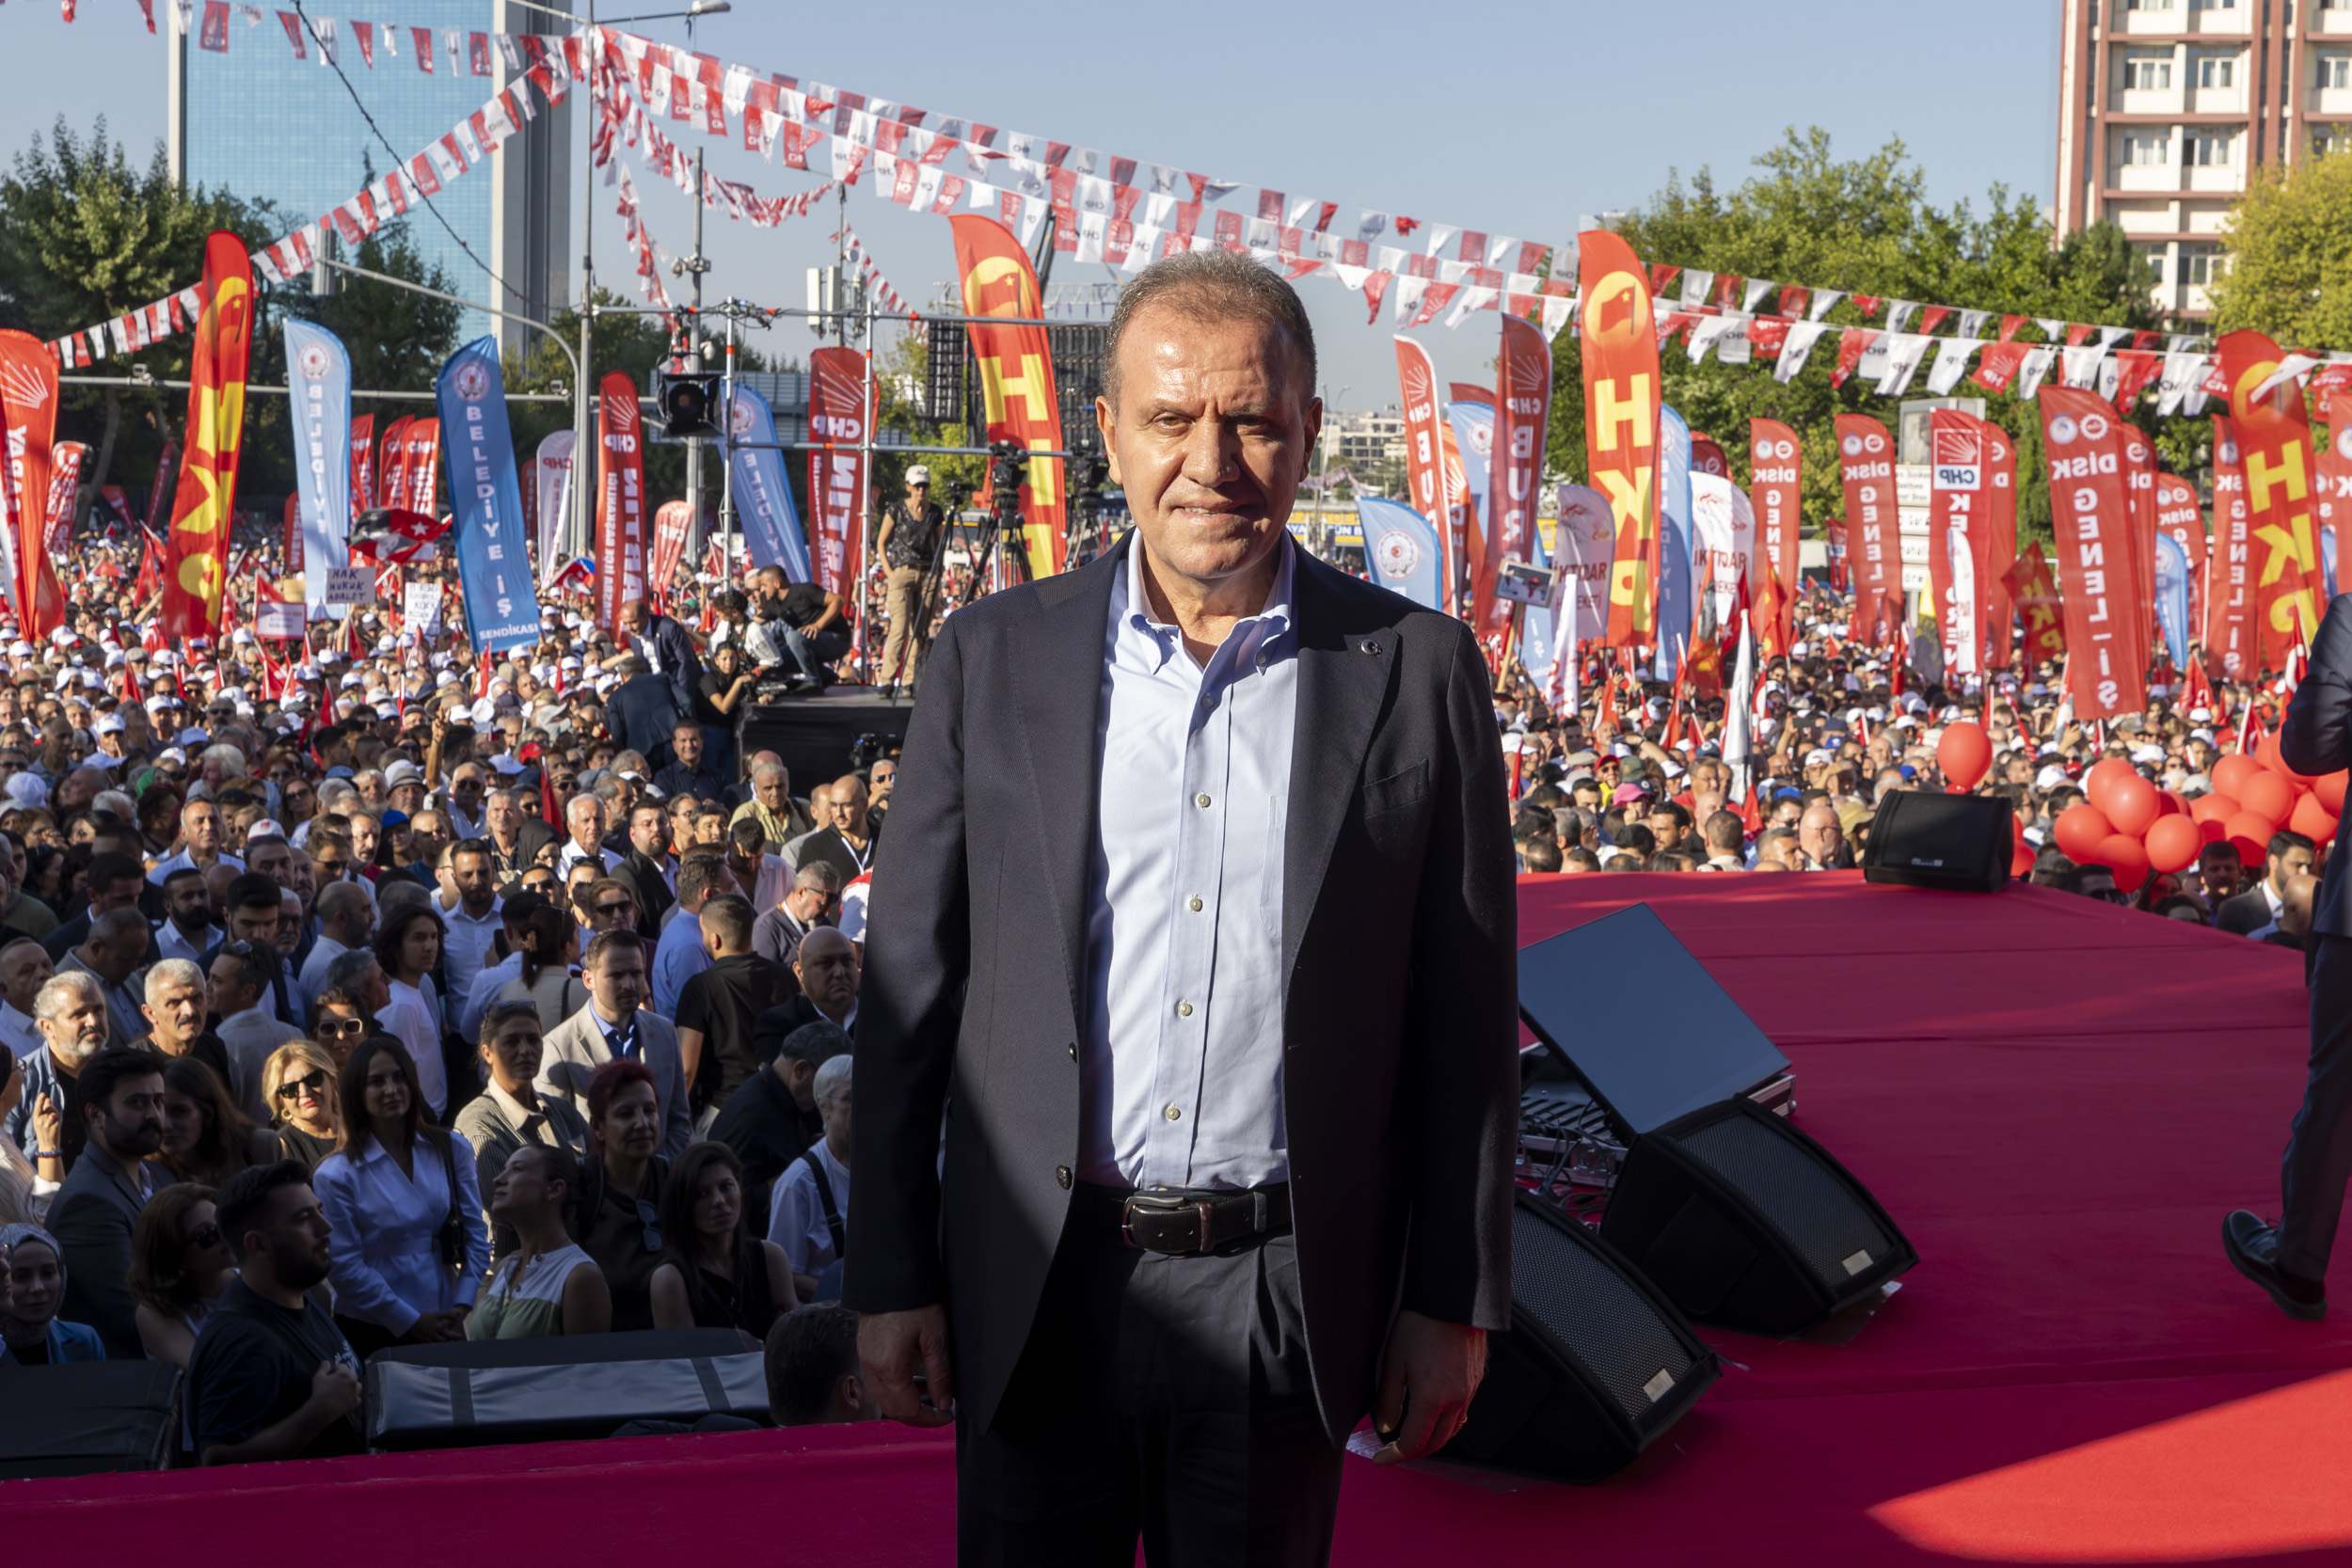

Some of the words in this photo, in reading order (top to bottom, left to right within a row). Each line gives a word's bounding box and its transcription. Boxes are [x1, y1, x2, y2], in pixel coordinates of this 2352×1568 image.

[465, 404, 504, 561] BELEDİYE
[496, 574, 514, 617] İŞ
[332, 568, 359, 579] HAK
[329, 581, 365, 592] HUKUK
[328, 592, 366, 601] ADALET
[479, 622, 539, 641] SENDİKASI
